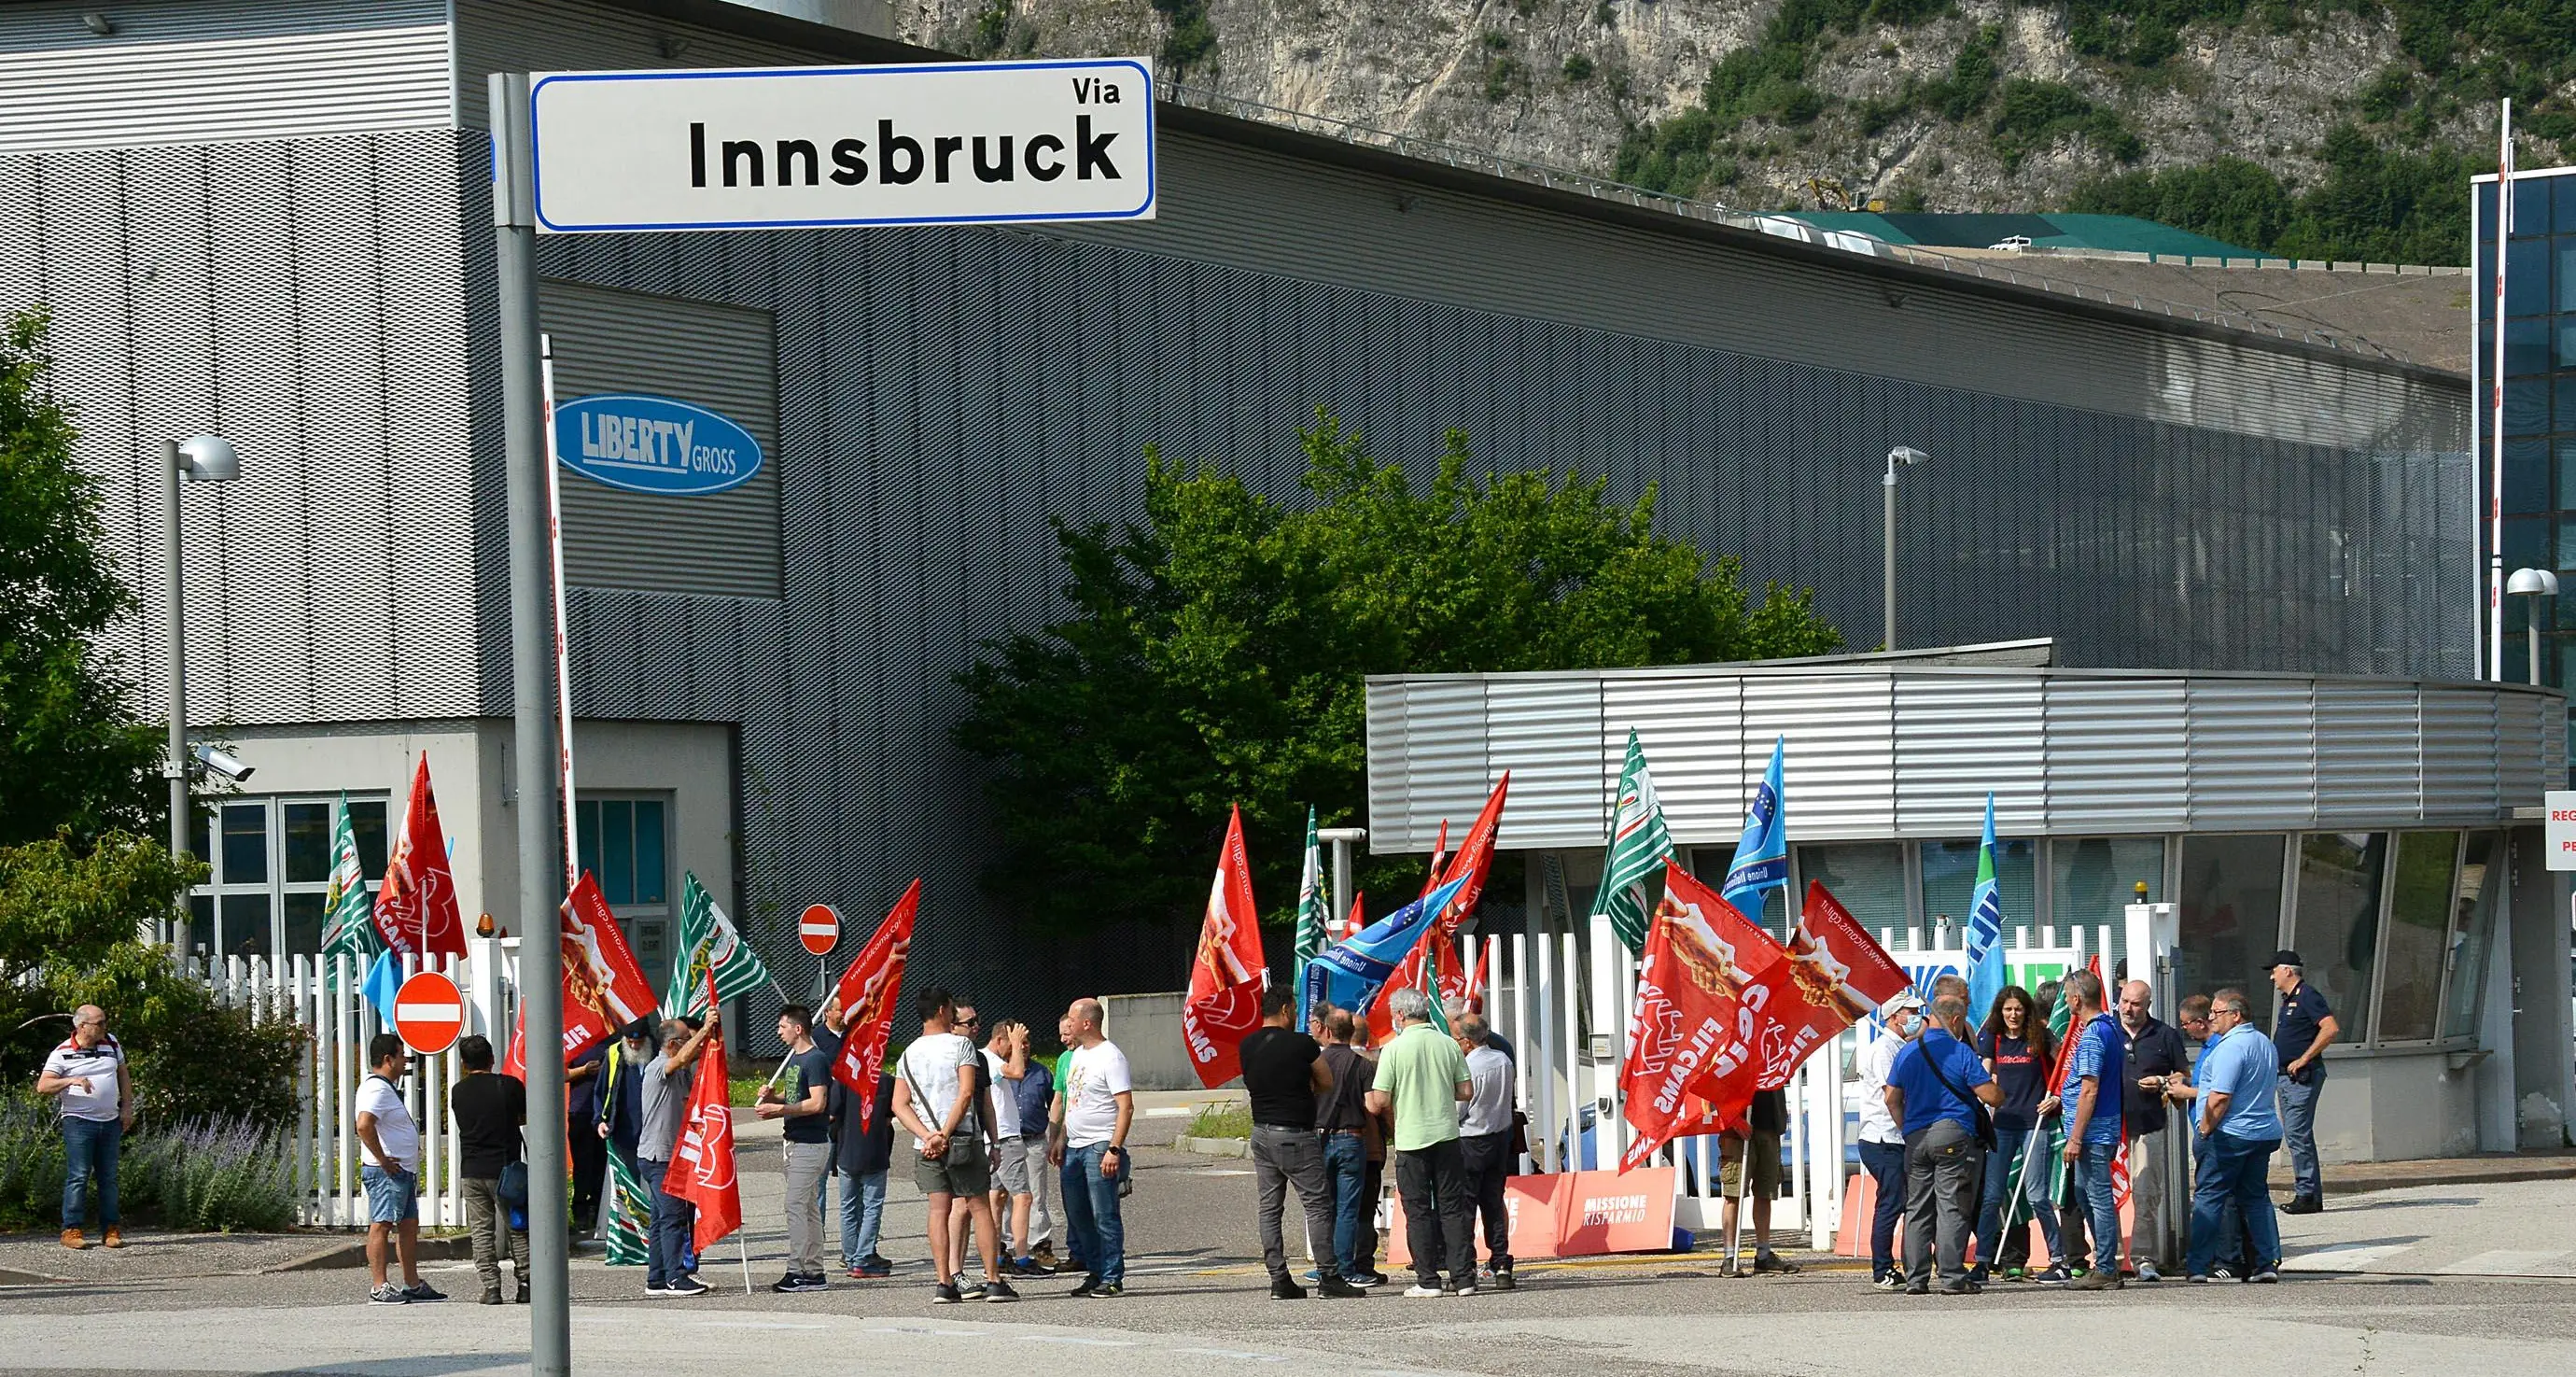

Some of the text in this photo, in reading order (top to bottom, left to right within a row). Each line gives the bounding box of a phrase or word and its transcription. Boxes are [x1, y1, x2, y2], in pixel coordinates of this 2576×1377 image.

[1071, 77, 1120, 105] Via
[689, 114, 1122, 188] Innsbruck
[581, 411, 736, 475] LIBERTY GROSS
[1583, 1208, 1646, 1227] RISPARMIO
[1584, 1194, 1647, 1213] MISSIONE
